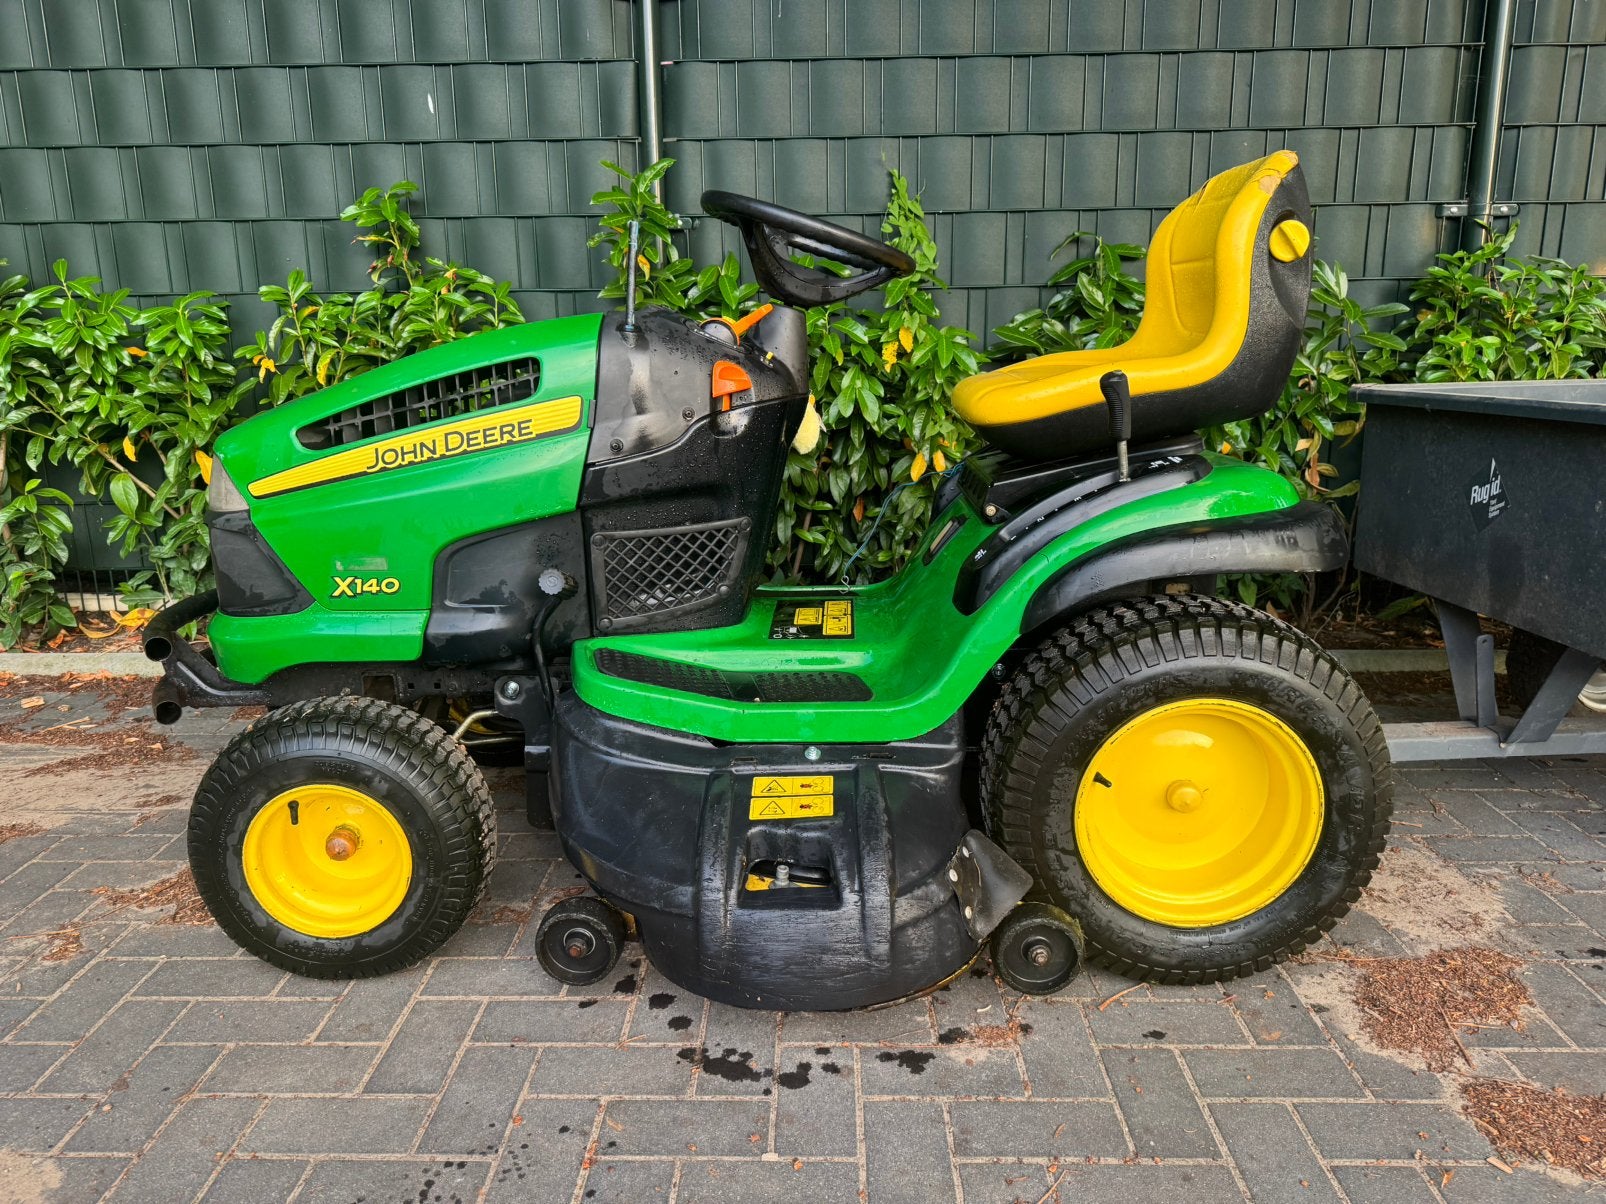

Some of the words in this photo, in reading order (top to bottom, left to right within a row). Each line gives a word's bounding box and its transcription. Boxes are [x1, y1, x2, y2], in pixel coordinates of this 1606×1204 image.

[366, 439, 438, 470] JOHN
[444, 419, 534, 453] DEERE
[331, 576, 401, 598] X140
